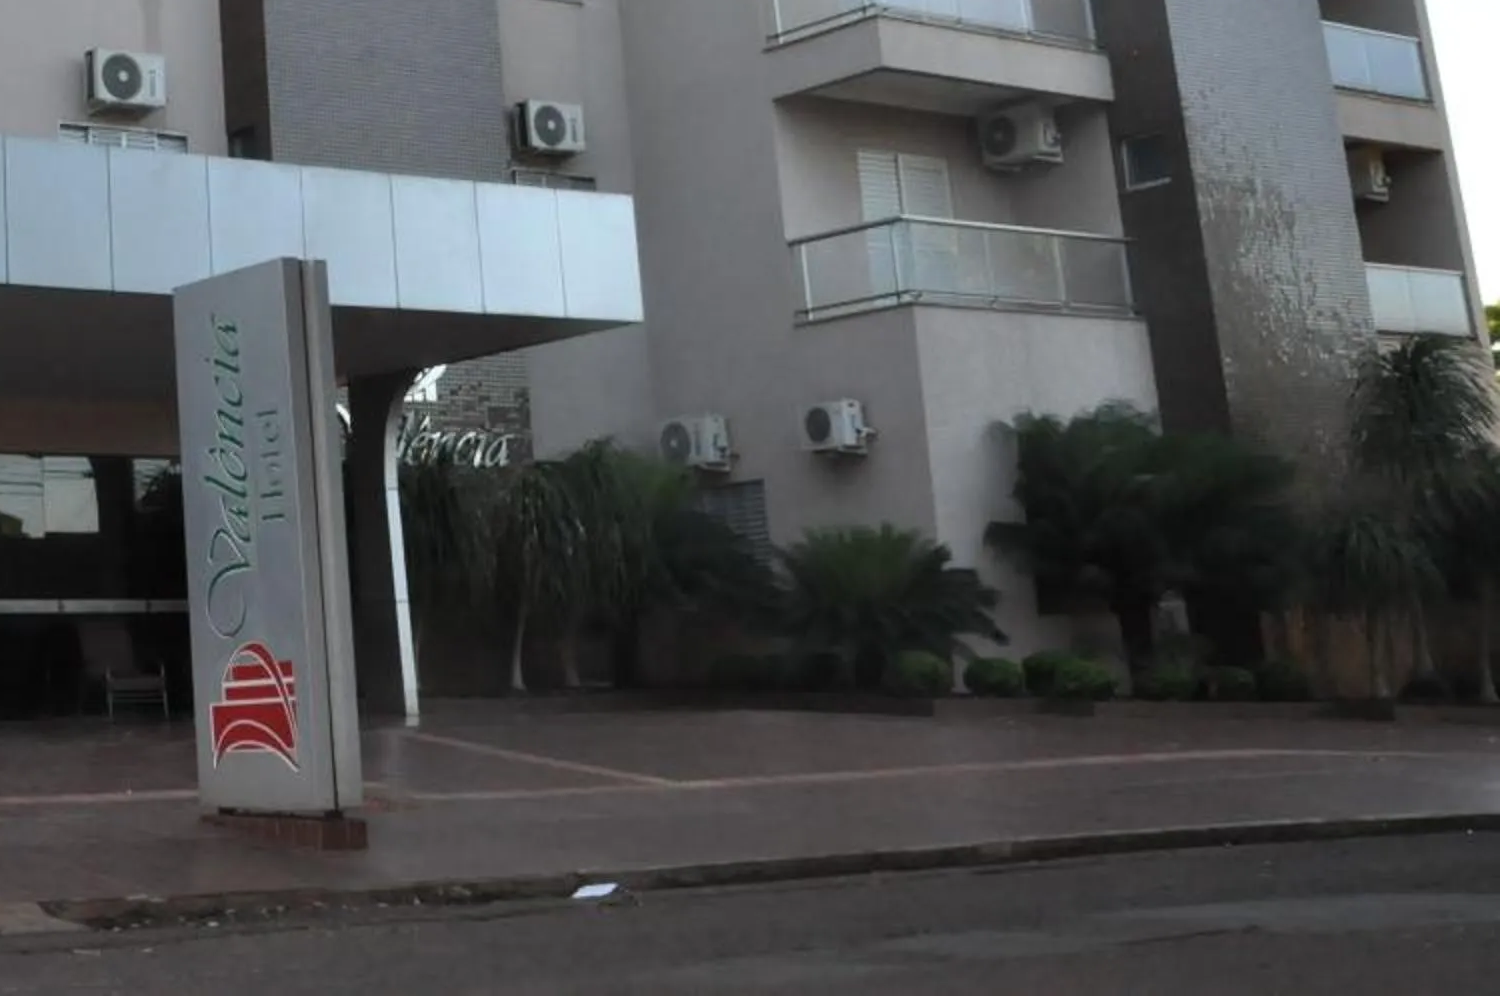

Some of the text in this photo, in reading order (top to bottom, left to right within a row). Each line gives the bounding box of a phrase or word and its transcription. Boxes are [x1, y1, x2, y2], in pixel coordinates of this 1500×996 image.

[204, 313, 252, 638] Valência
[255, 408, 286, 521] Hotel
[396, 407, 515, 469] lência
